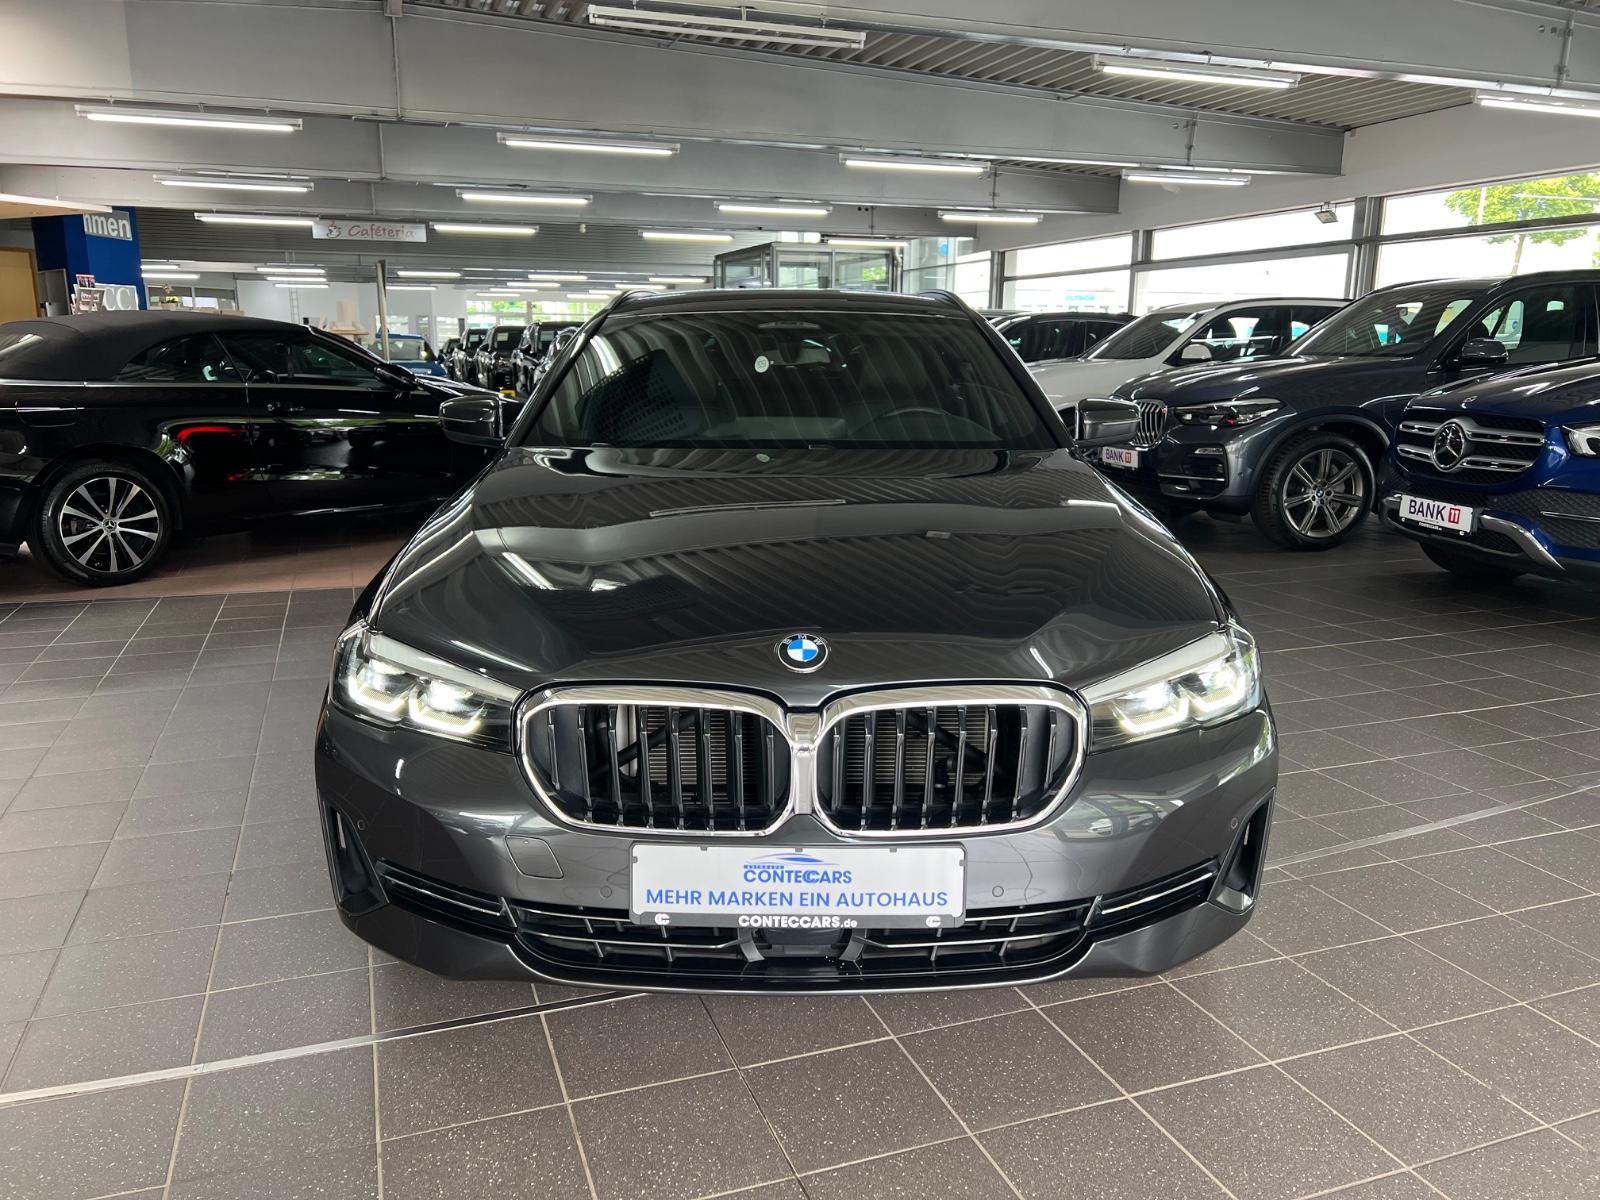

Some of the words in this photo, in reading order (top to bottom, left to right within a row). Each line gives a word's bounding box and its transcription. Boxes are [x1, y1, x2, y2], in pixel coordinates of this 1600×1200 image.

[1105, 449, 1124, 463] BANK
[1408, 499, 1447, 521] BANK
[1449, 509, 1460, 523] 11
[646, 889, 702, 905] MEHR
[707, 890, 794, 907] MARKEN
[799, 891, 831, 907] EIN
[836, 891, 948, 907] AUTOHAUS
[738, 915, 858, 929] CONTECCARS.de
